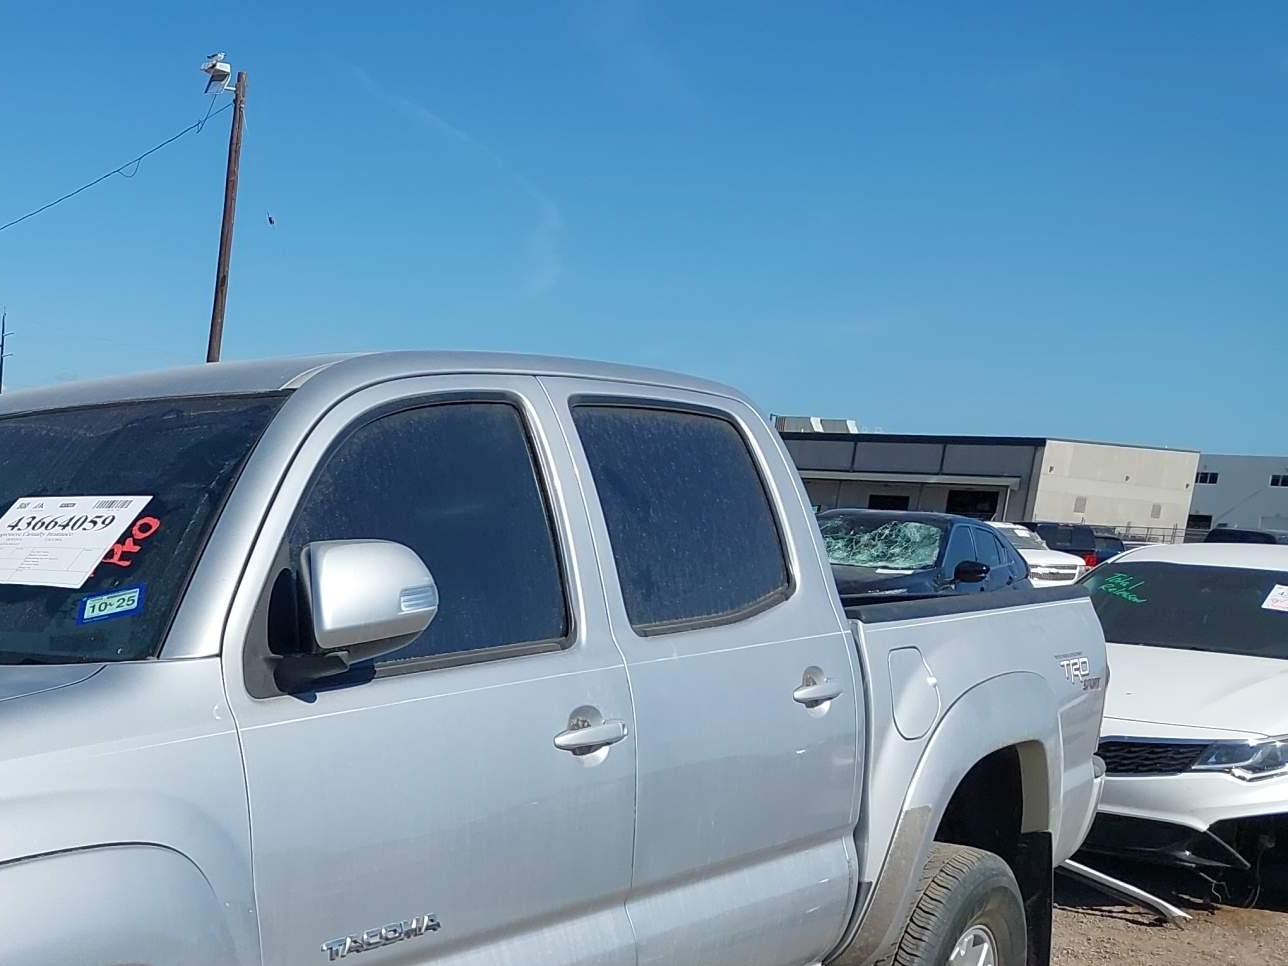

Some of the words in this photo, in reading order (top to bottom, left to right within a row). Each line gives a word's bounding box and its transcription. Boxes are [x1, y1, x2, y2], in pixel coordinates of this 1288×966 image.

[7, 514, 116, 532] 43664059
[1060, 657, 1090, 684] TRD
[320, 912, 441, 961] TACOMA
